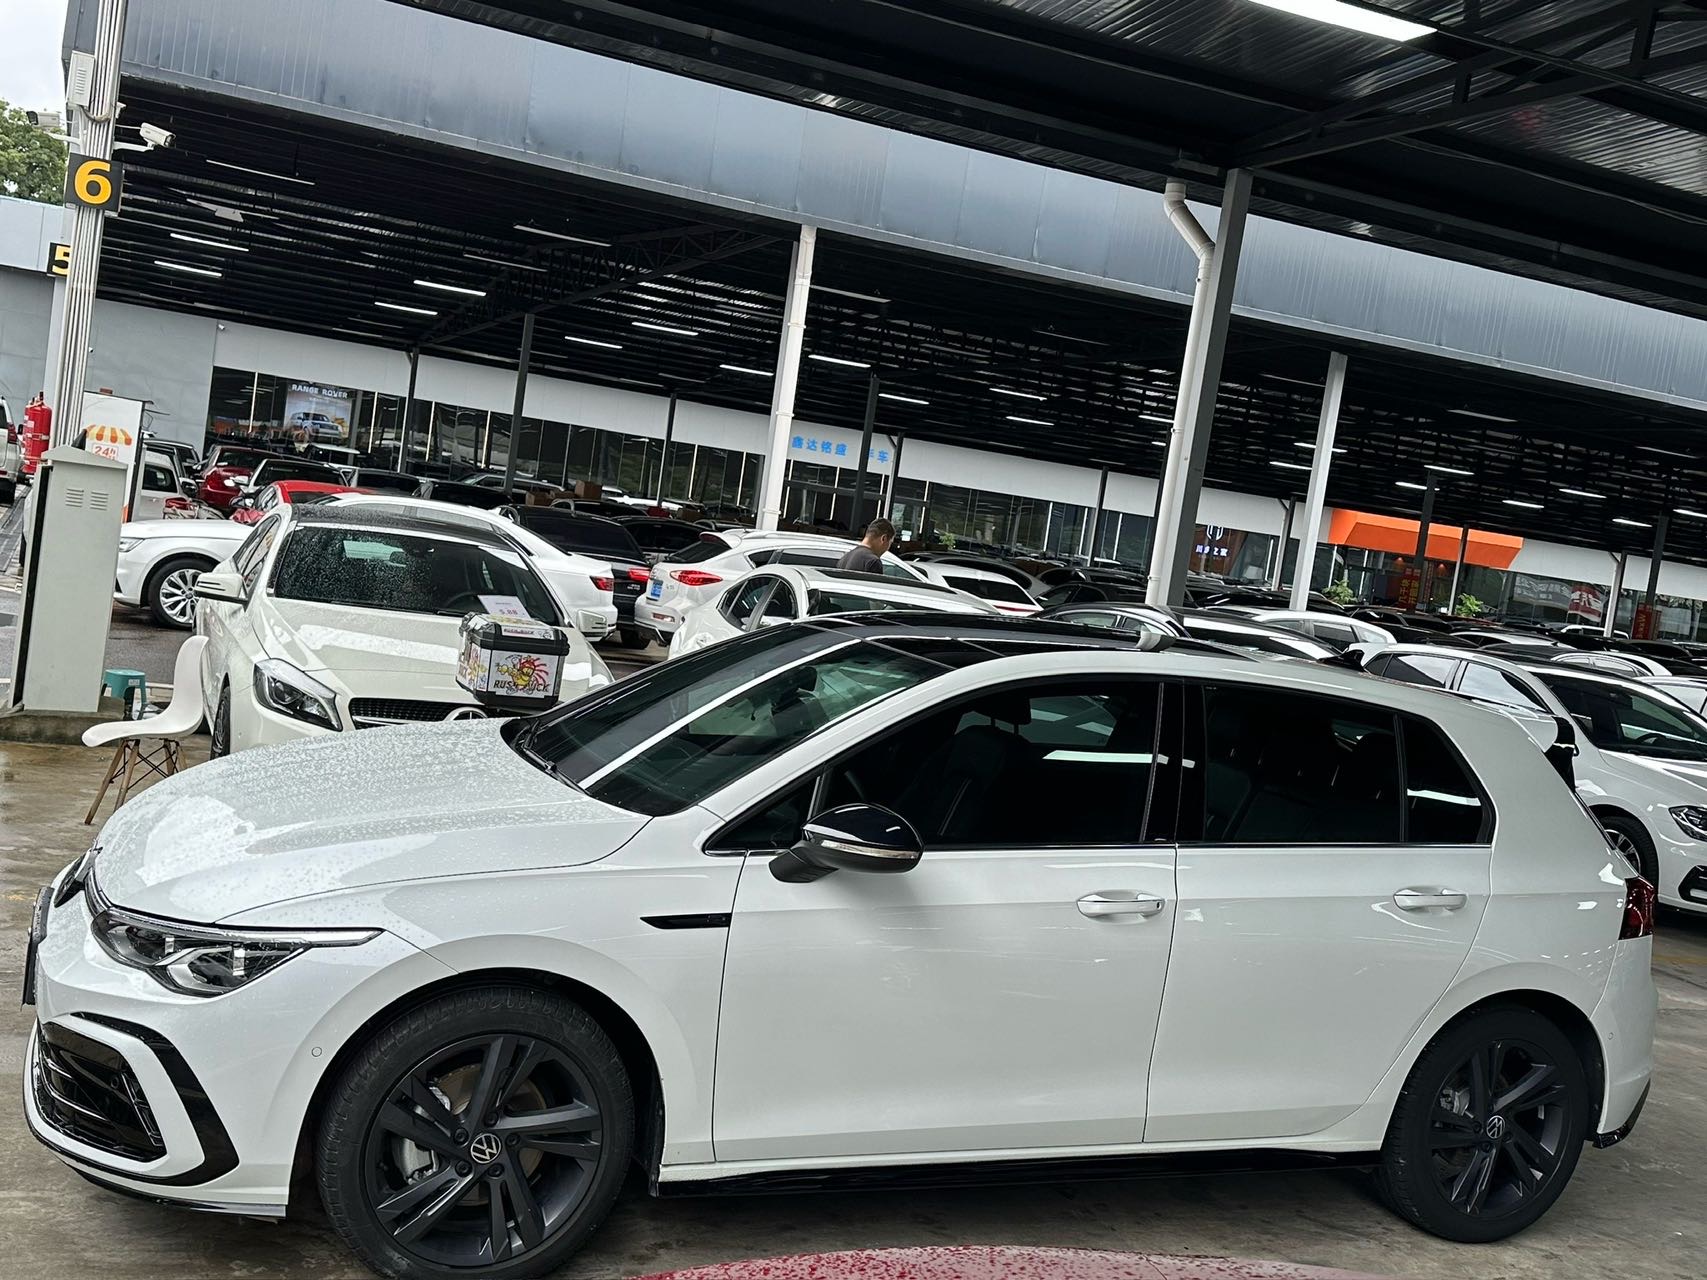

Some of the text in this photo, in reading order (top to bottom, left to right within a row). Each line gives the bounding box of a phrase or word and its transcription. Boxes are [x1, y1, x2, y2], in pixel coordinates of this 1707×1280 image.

[74, 160, 112, 205] 6
[51, 244, 71, 276] 5
[291, 383, 348, 399] RANGE ROVER
